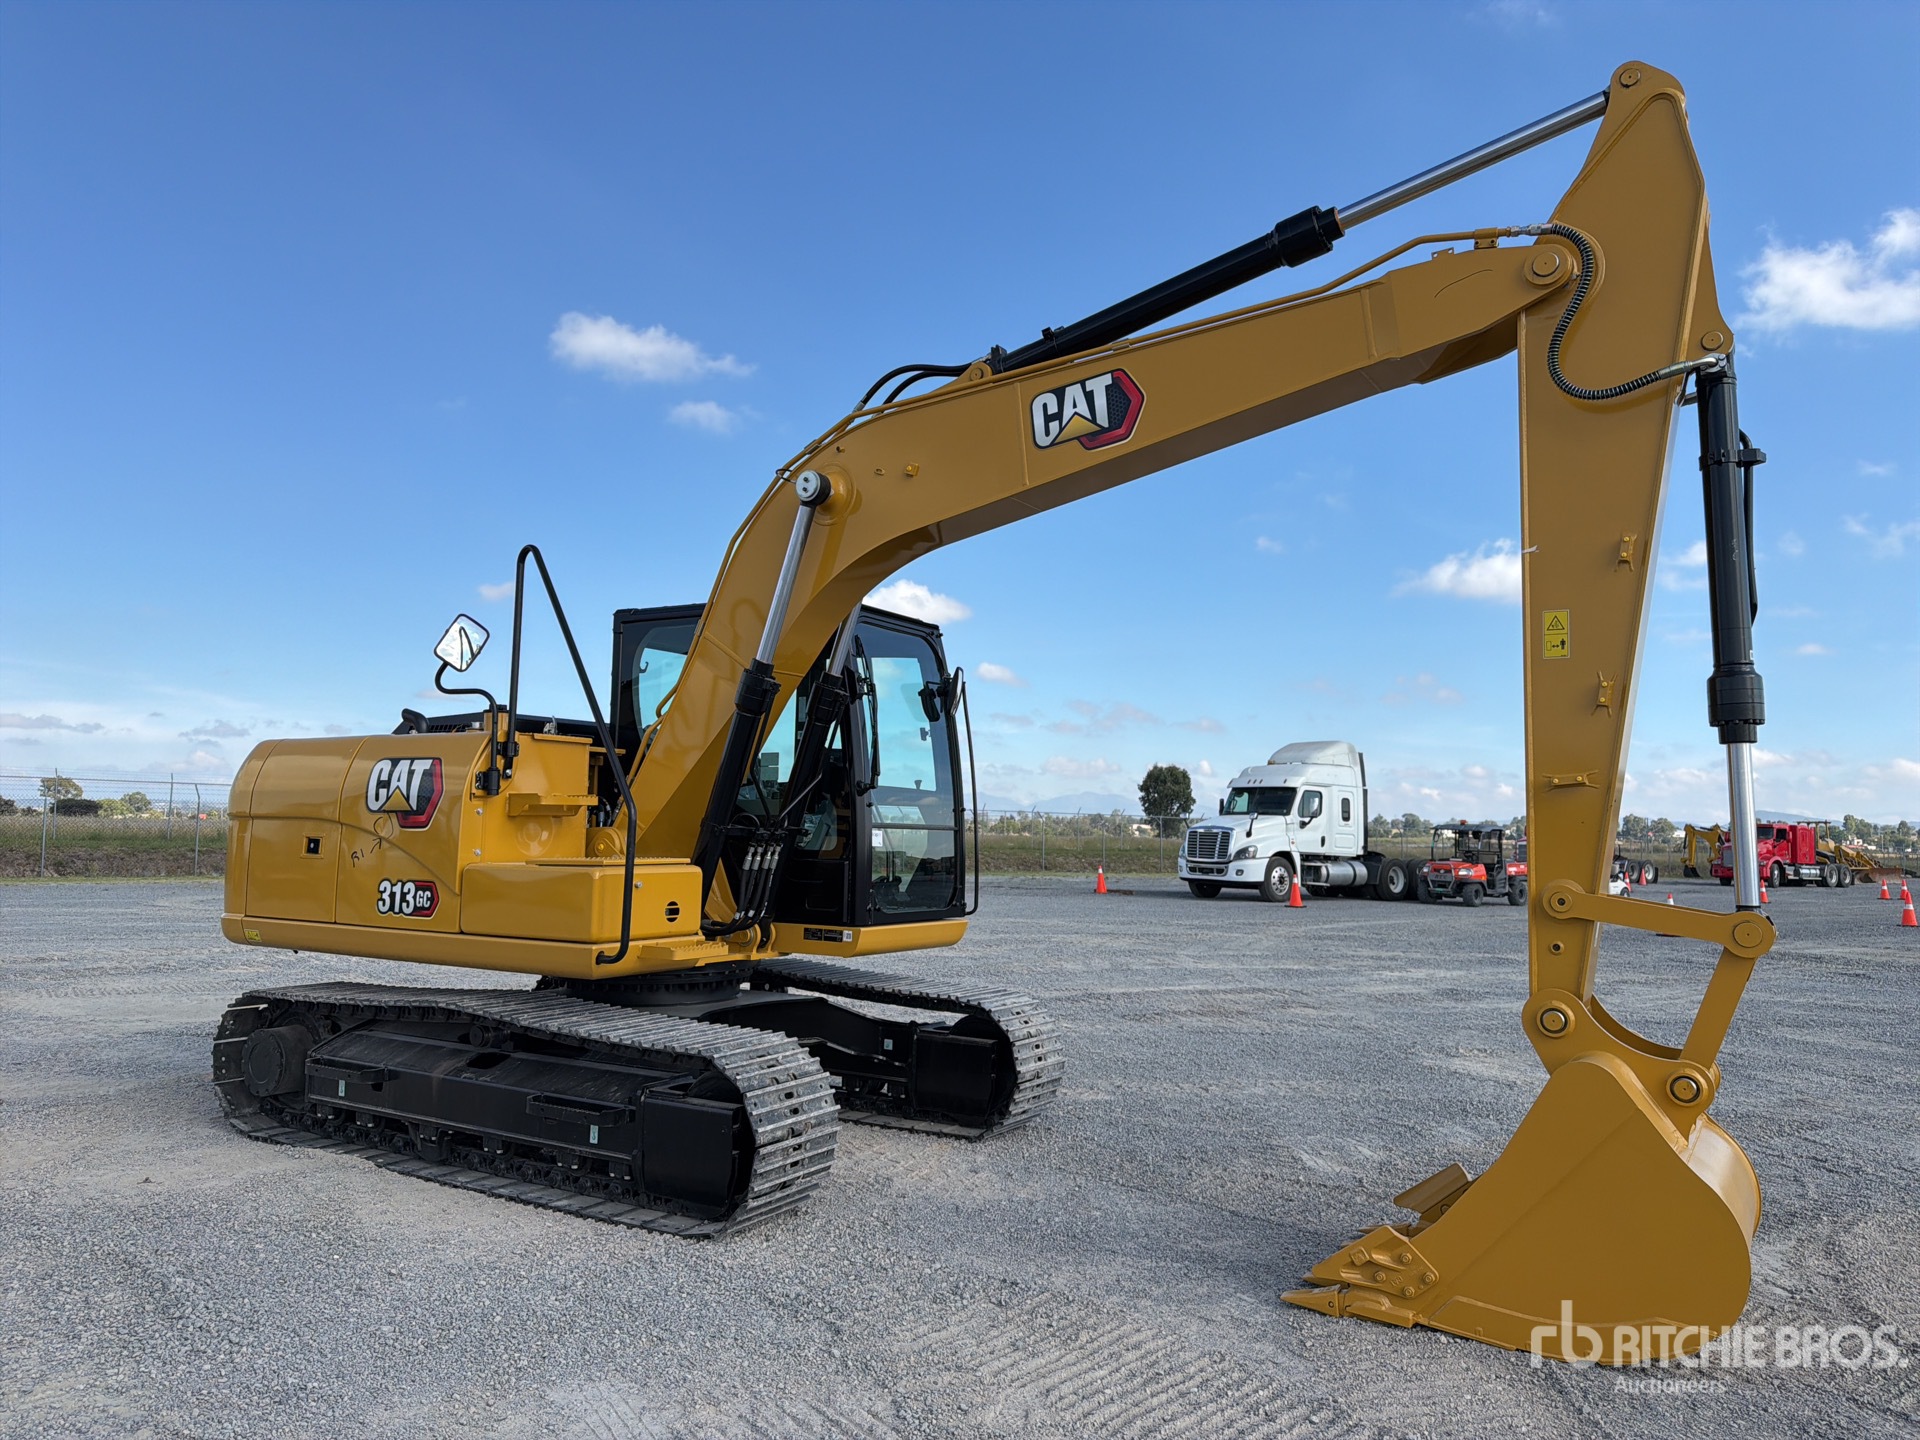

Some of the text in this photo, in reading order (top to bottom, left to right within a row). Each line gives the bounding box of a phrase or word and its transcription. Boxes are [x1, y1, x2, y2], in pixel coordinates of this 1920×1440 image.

[1032, 372, 1112, 447] CAT
[367, 759, 433, 811] CAT
[378, 880, 431, 914] 313 GC
